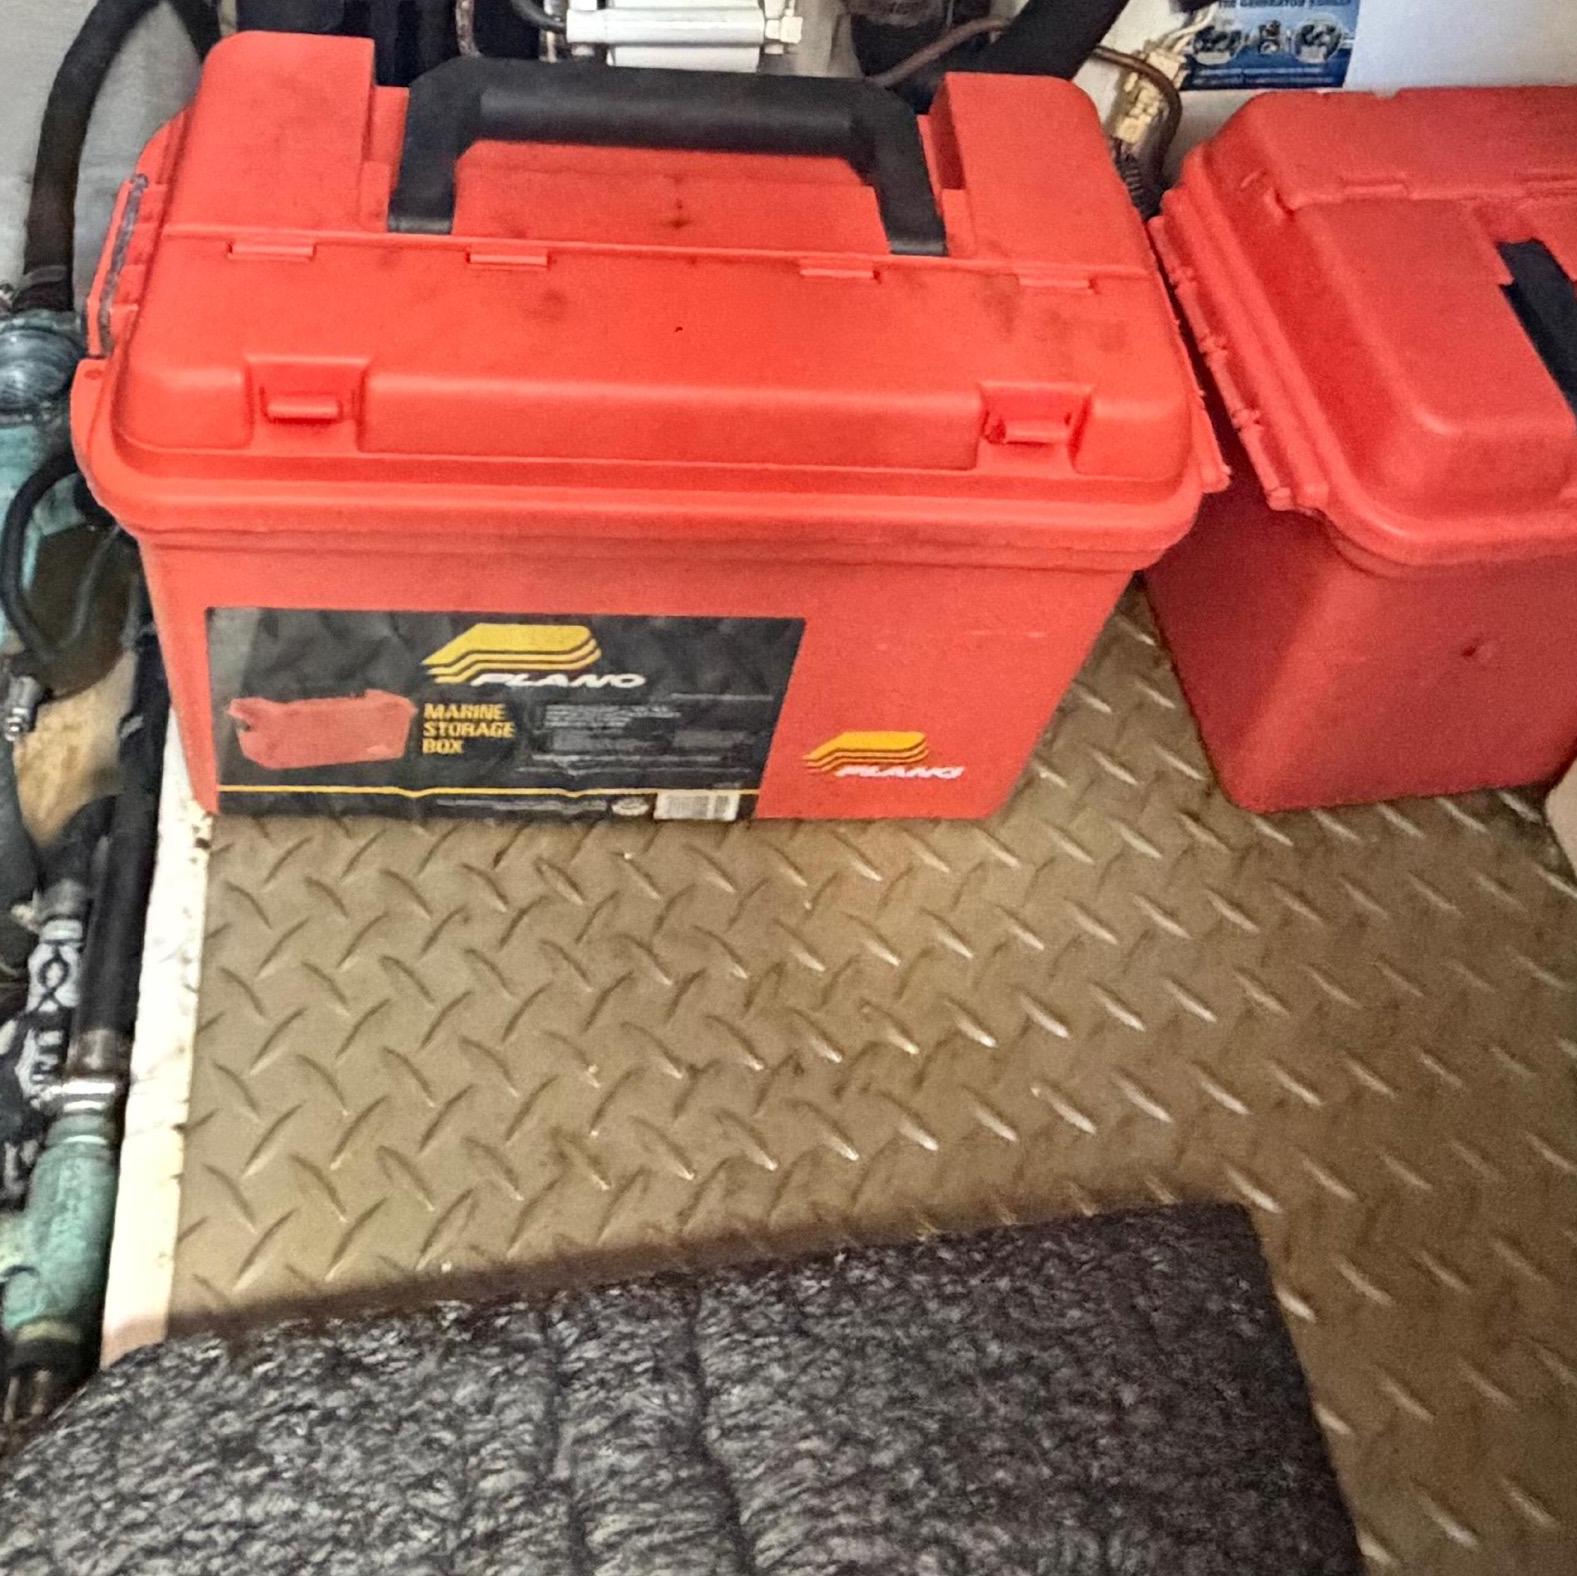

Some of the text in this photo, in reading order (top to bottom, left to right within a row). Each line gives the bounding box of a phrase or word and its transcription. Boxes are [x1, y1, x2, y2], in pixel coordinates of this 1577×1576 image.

[470, 673, 647, 688] PLANO
[423, 703, 506, 720] MARINE
[423, 721, 516, 738] STORAGE
[422, 738, 465, 755] BOX
